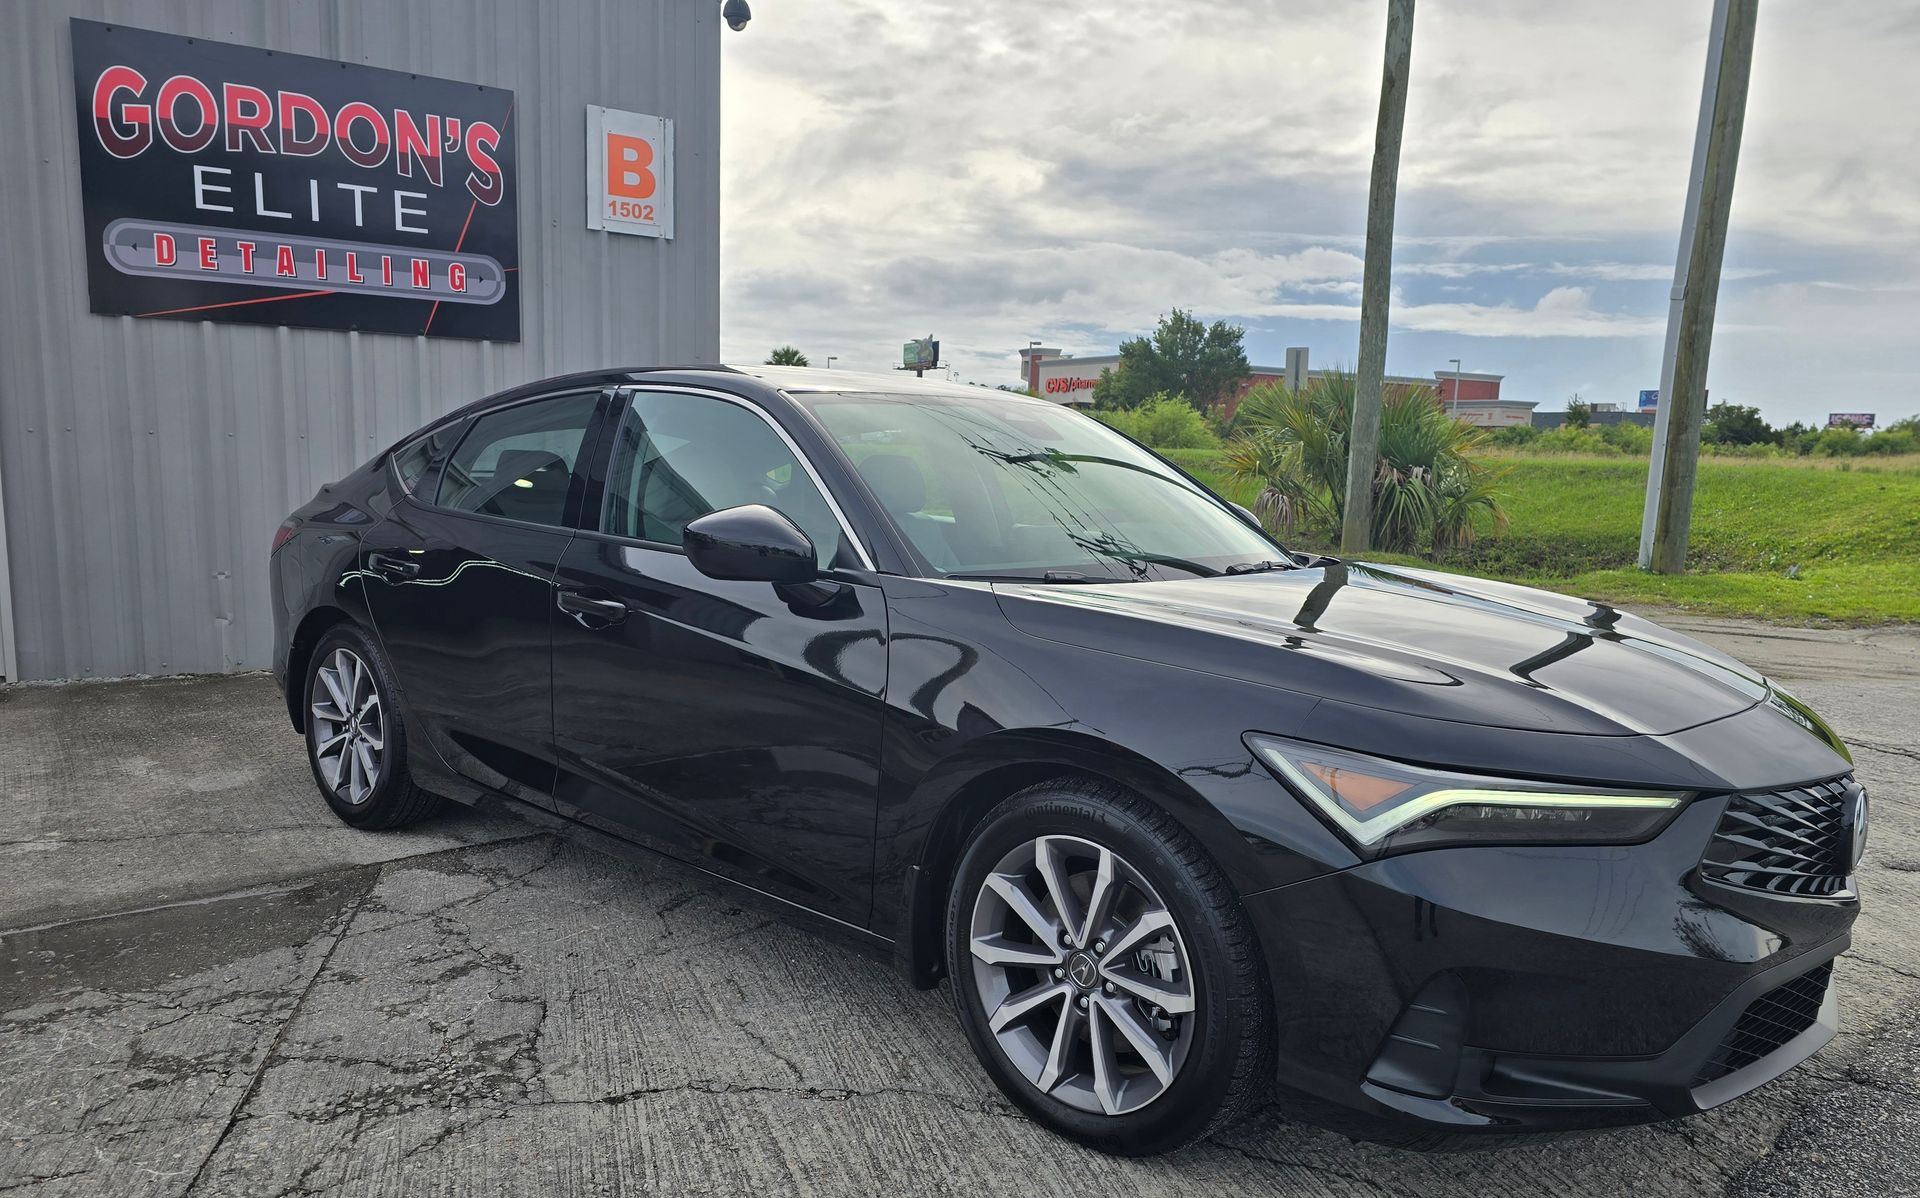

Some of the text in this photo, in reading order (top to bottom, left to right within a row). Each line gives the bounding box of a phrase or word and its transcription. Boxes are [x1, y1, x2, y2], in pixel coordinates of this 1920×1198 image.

[92, 64, 504, 207] GORDON'S
[607, 132, 657, 200] B
[192, 164, 430, 235] ELITE
[608, 199, 655, 221] 1502
[152, 232, 469, 293] DETAILING
